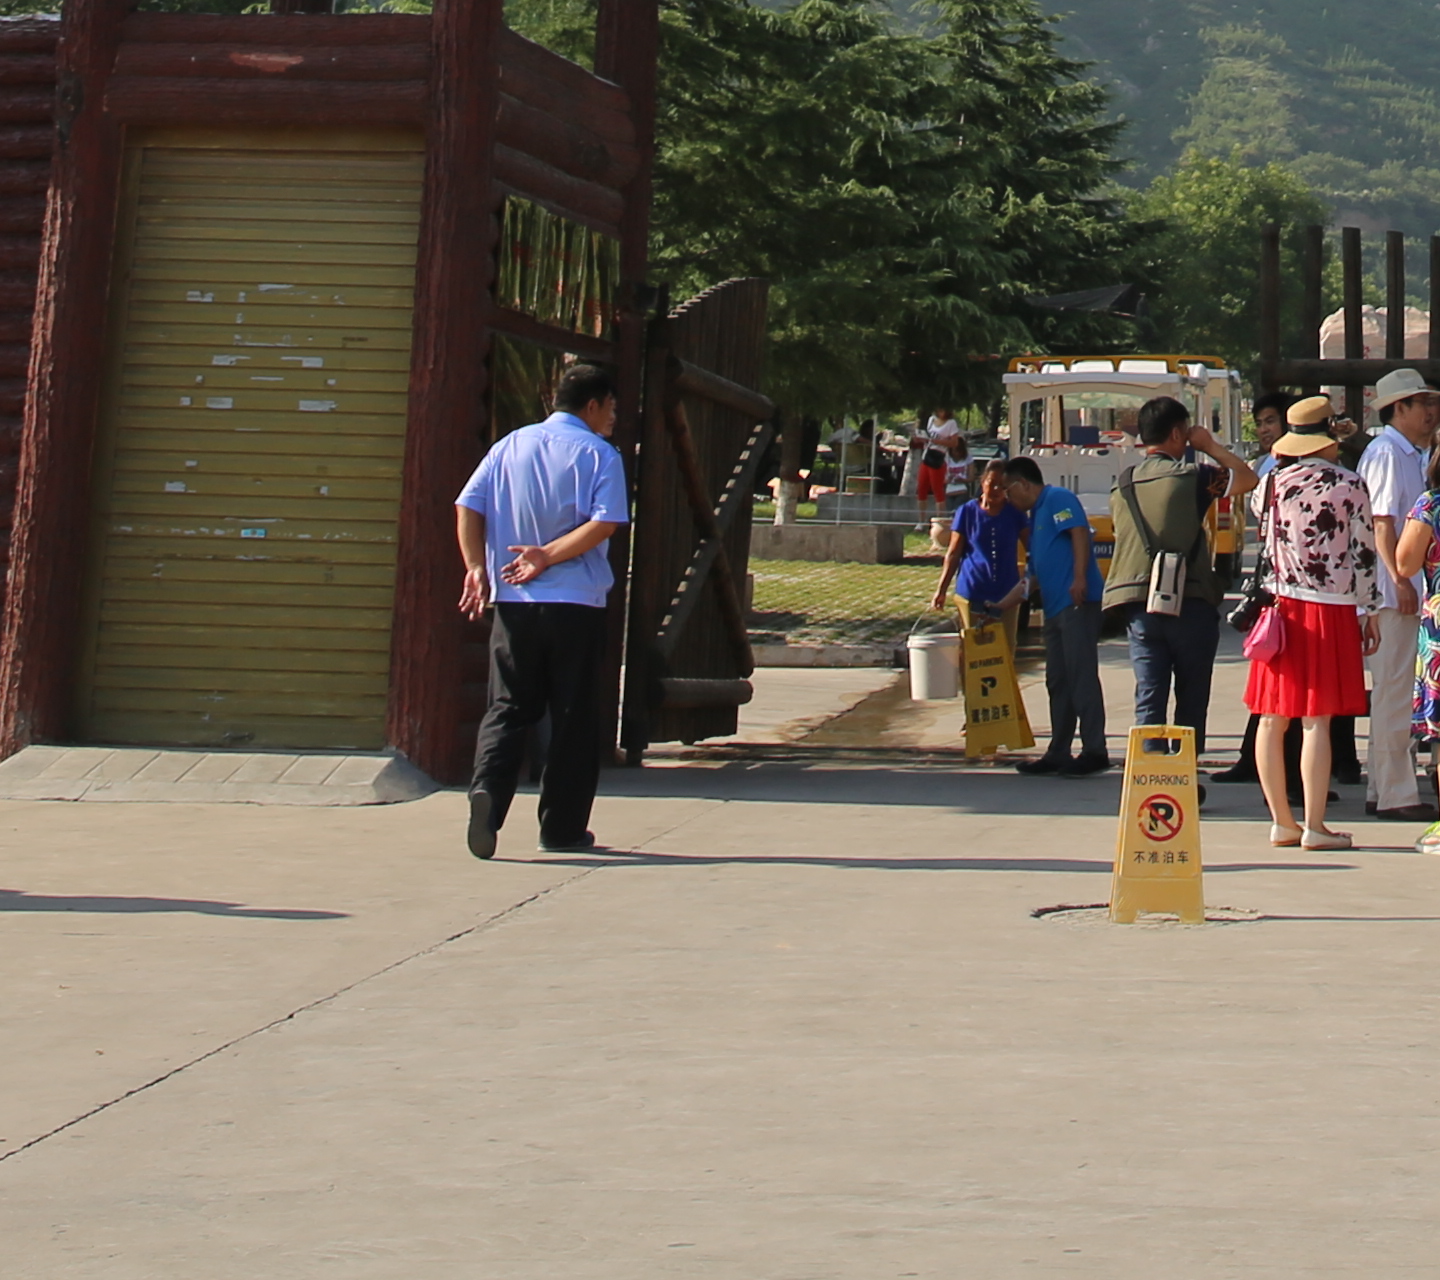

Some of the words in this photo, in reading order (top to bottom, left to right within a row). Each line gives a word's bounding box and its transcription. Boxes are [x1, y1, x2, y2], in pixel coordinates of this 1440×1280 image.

[1133, 775, 1148, 786] NO
[1149, 775, 1189, 786] PARKING
[1133, 850, 1189, 864] 不准泊车
